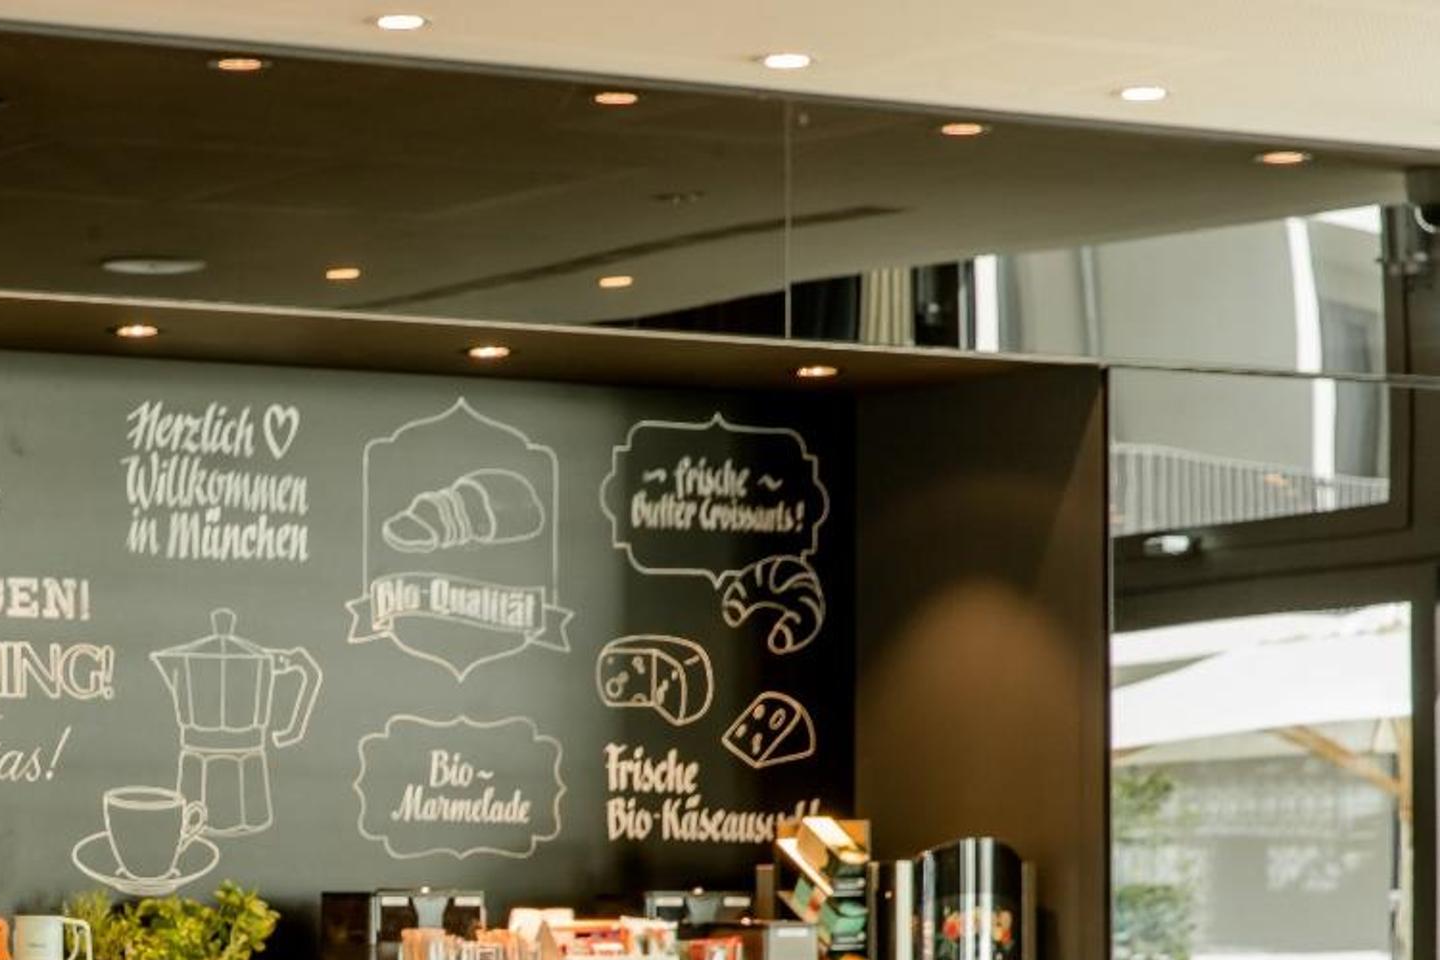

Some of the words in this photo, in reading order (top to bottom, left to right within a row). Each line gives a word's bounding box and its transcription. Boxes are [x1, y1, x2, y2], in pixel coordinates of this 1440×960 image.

[126, 400, 255, 458] Herzlich
[120, 450, 310, 515] Willkommen
[126, 506, 160, 556] in
[166, 506, 310, 562] München
[604, 742, 701, 795] Frische
[390, 783, 532, 824] Marmelade
